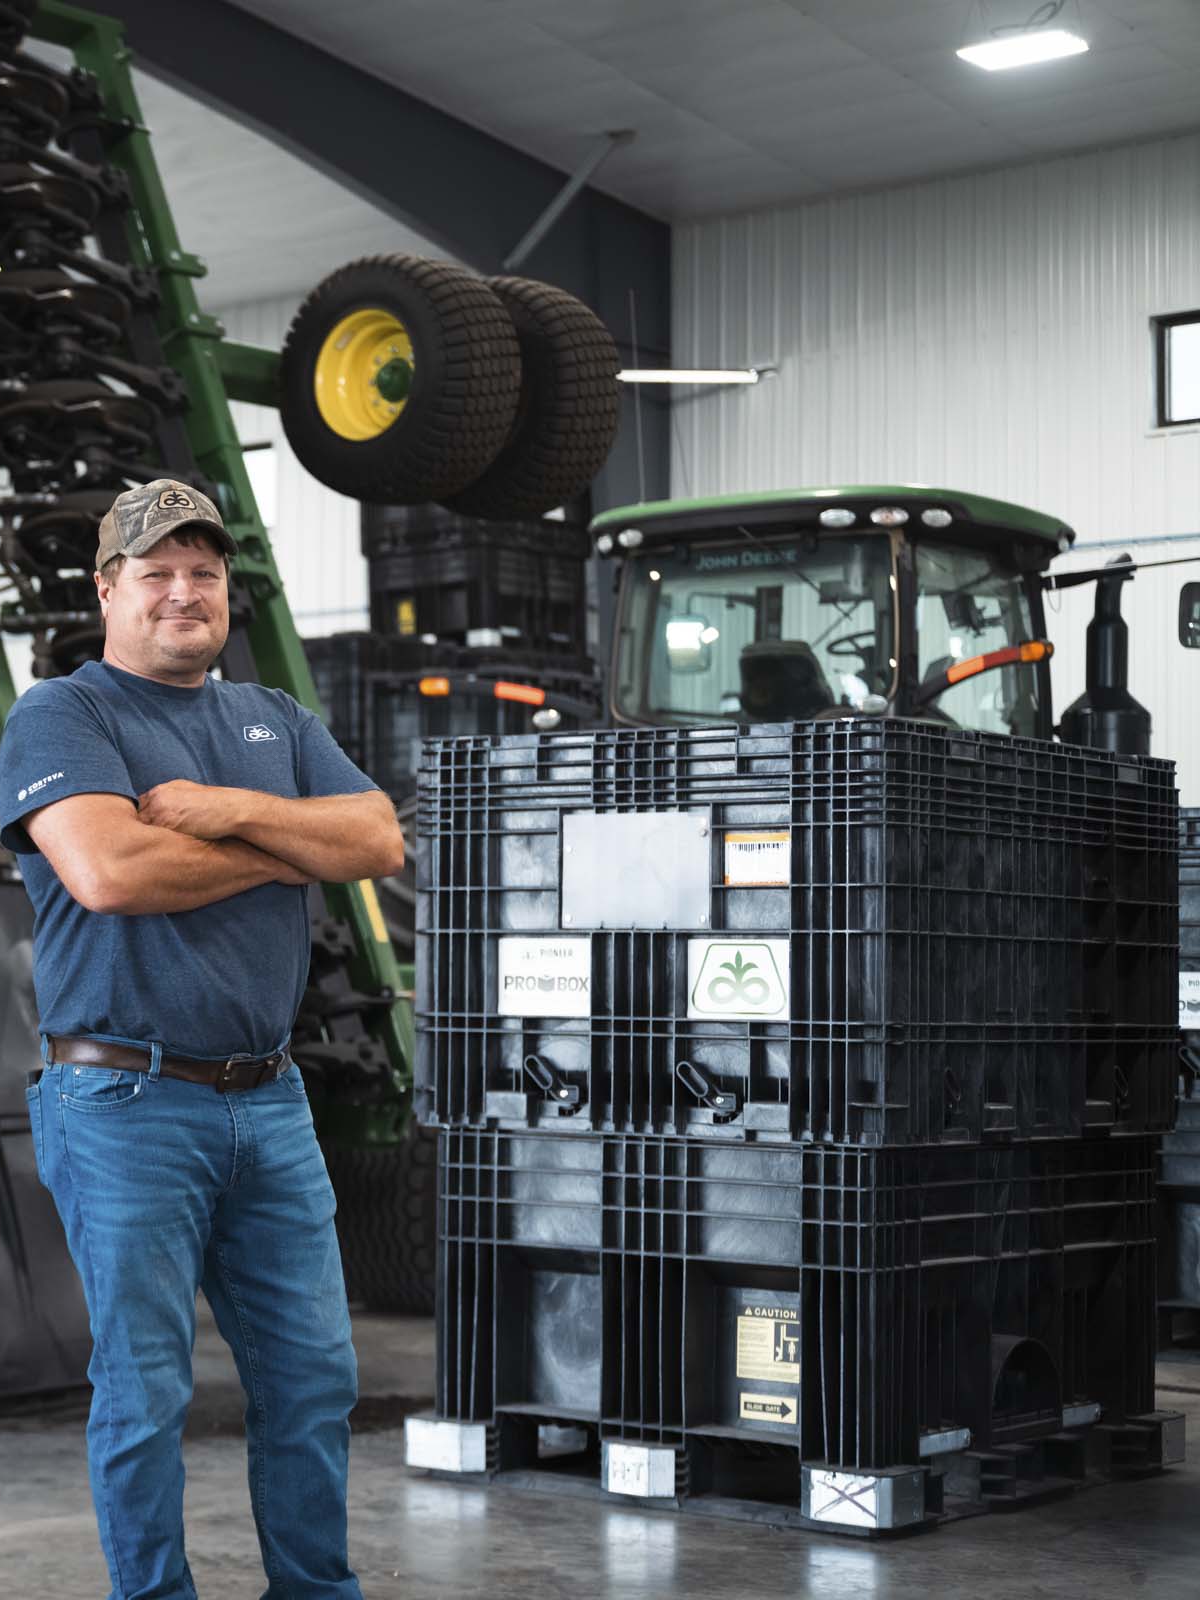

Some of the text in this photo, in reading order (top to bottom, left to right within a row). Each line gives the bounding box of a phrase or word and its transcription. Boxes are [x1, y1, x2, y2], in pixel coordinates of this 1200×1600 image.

[695, 552, 738, 571] JOHN
[28, 771, 64, 792] CORTEVA
[754, 1306, 797, 1320] CAUTION
